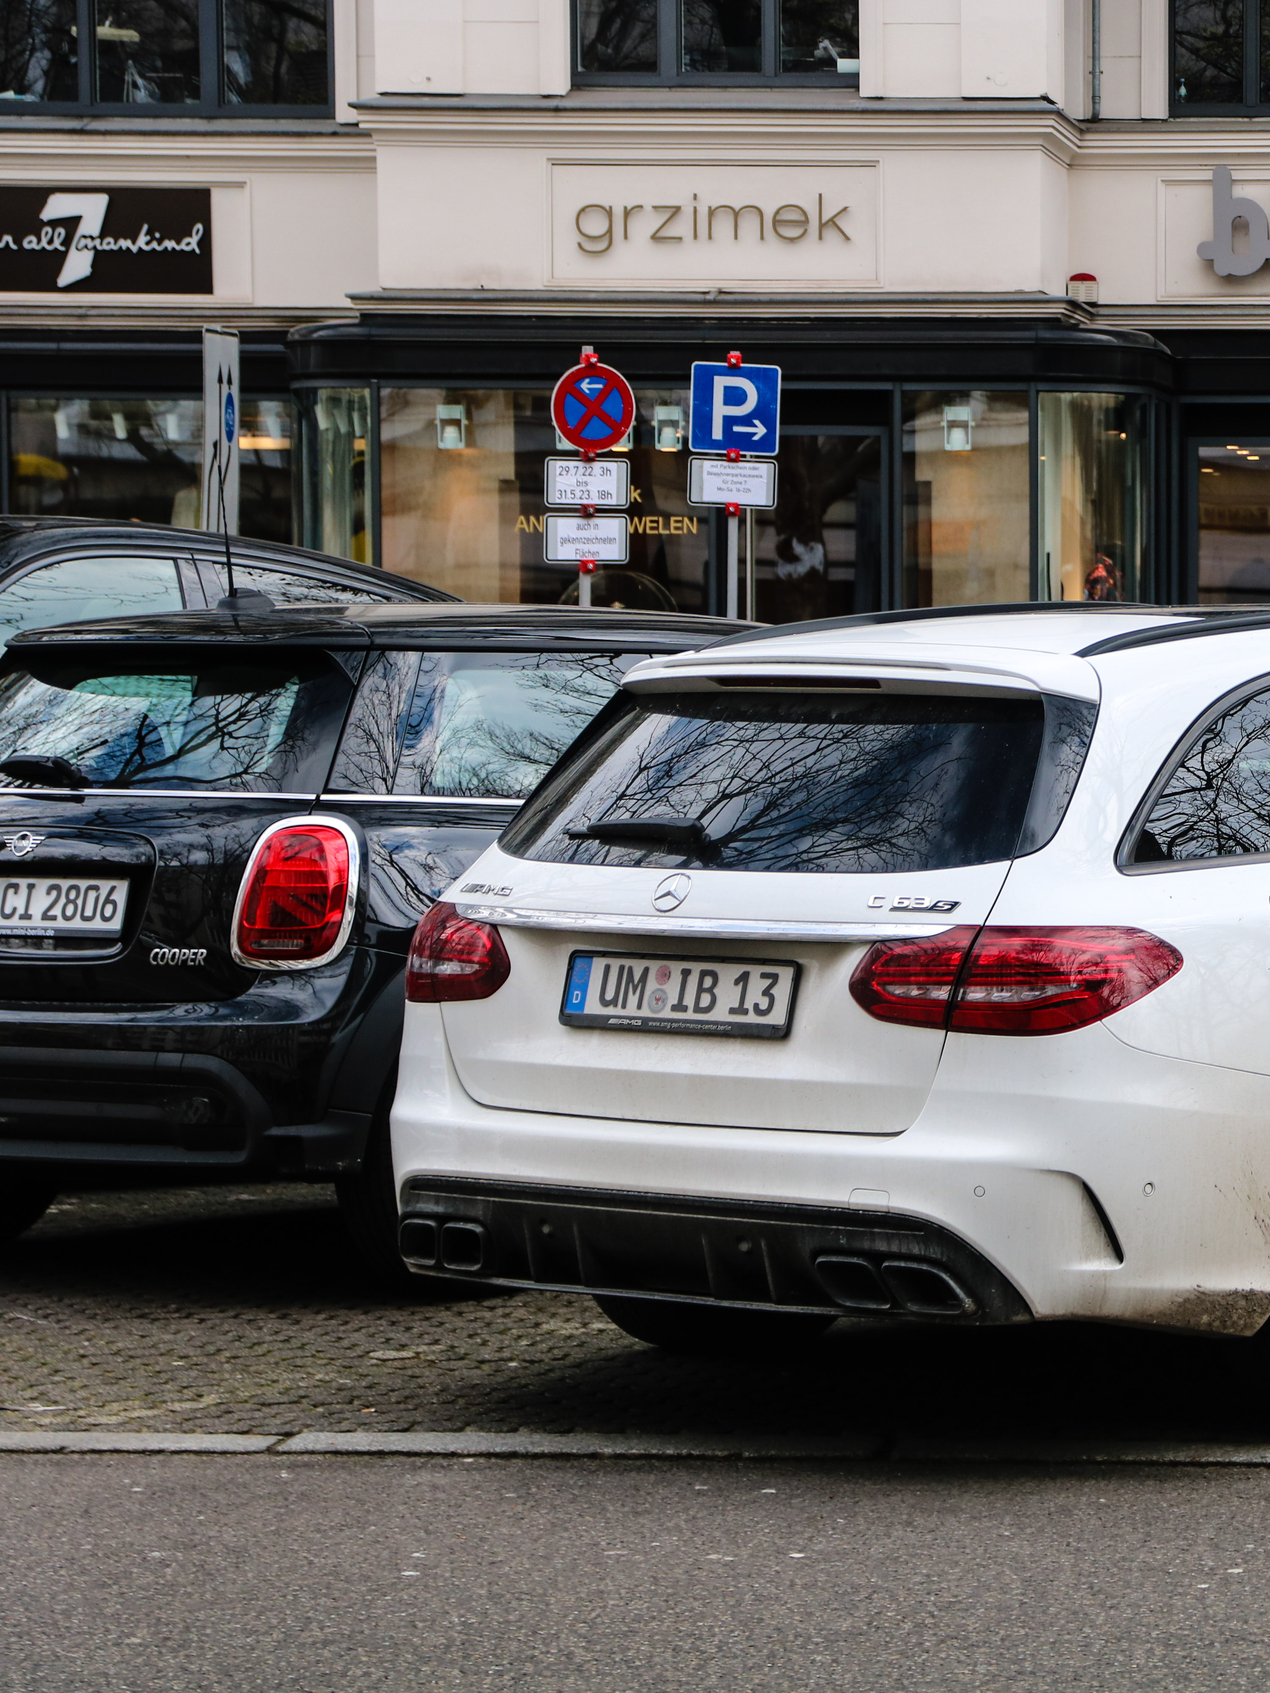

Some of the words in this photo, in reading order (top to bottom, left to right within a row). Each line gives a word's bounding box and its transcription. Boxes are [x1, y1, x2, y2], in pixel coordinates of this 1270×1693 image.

[575, 193, 851, 254] grzimek
[22, 226, 66, 251] all
[76, 223, 204, 254] mankind
[39, 192, 110, 288] 7
[711, 375, 758, 440] P
[599, 466, 612, 477] 3h
[719, 463, 747, 471] Parkschein
[575, 479, 589, 487] bis
[596, 489, 613, 500] 18h
[576, 521, 591, 531] auch
[592, 521, 599, 531] in
[629, 516, 698, 534] WELEN
[574, 548, 600, 559] Flächen
[473, 883, 514, 897] AMG
[40, 883, 118, 923] 2806
[867, 894, 887, 909] C
[149, 948, 208, 967] COOPER
[598, 963, 650, 1011] UM
[670, 967, 719, 1015] IB
[728, 970, 780, 1017] 13
[572, 991, 581, 1004] D
[617, 1018, 643, 1027] AMG
